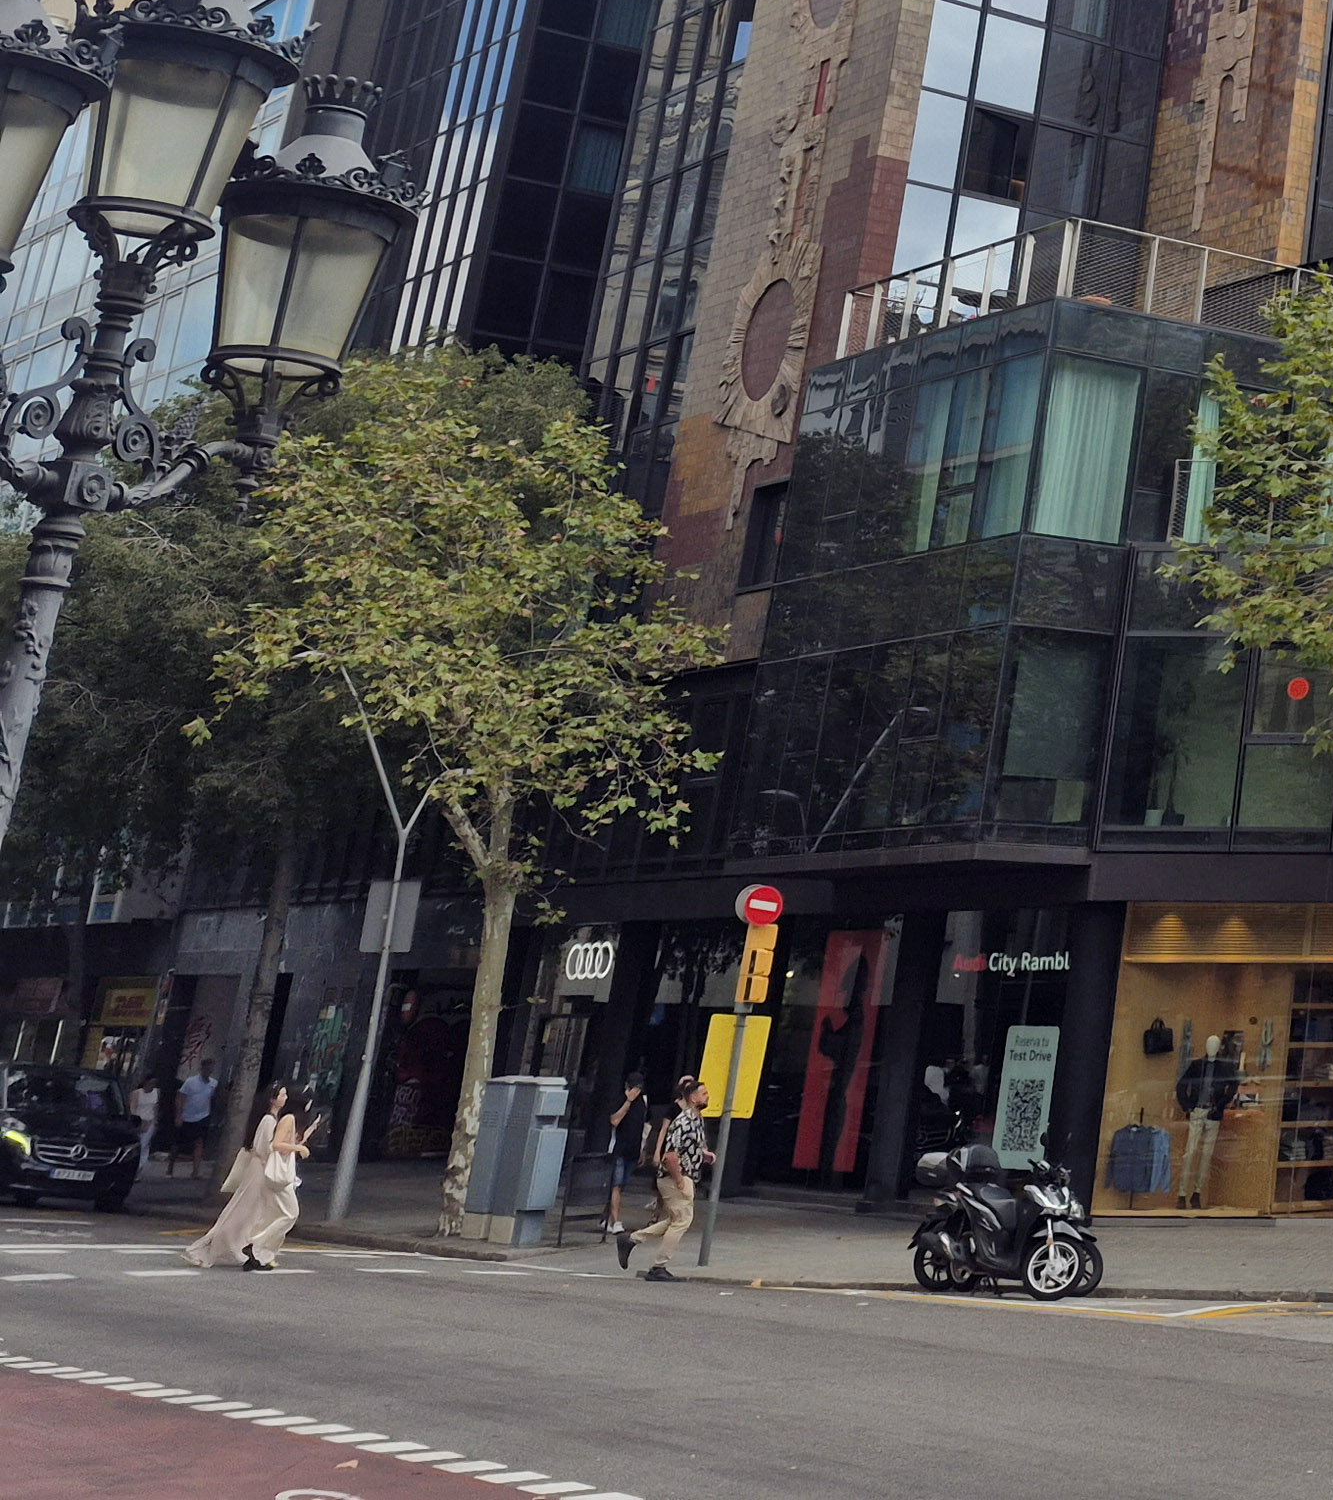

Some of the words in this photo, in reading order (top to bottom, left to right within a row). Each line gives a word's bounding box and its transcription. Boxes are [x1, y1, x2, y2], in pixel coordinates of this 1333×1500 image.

[988, 952, 1018, 977] City
[1009, 1050, 1026, 1061] Test
[1029, 1050, 1052, 1062] Drive
